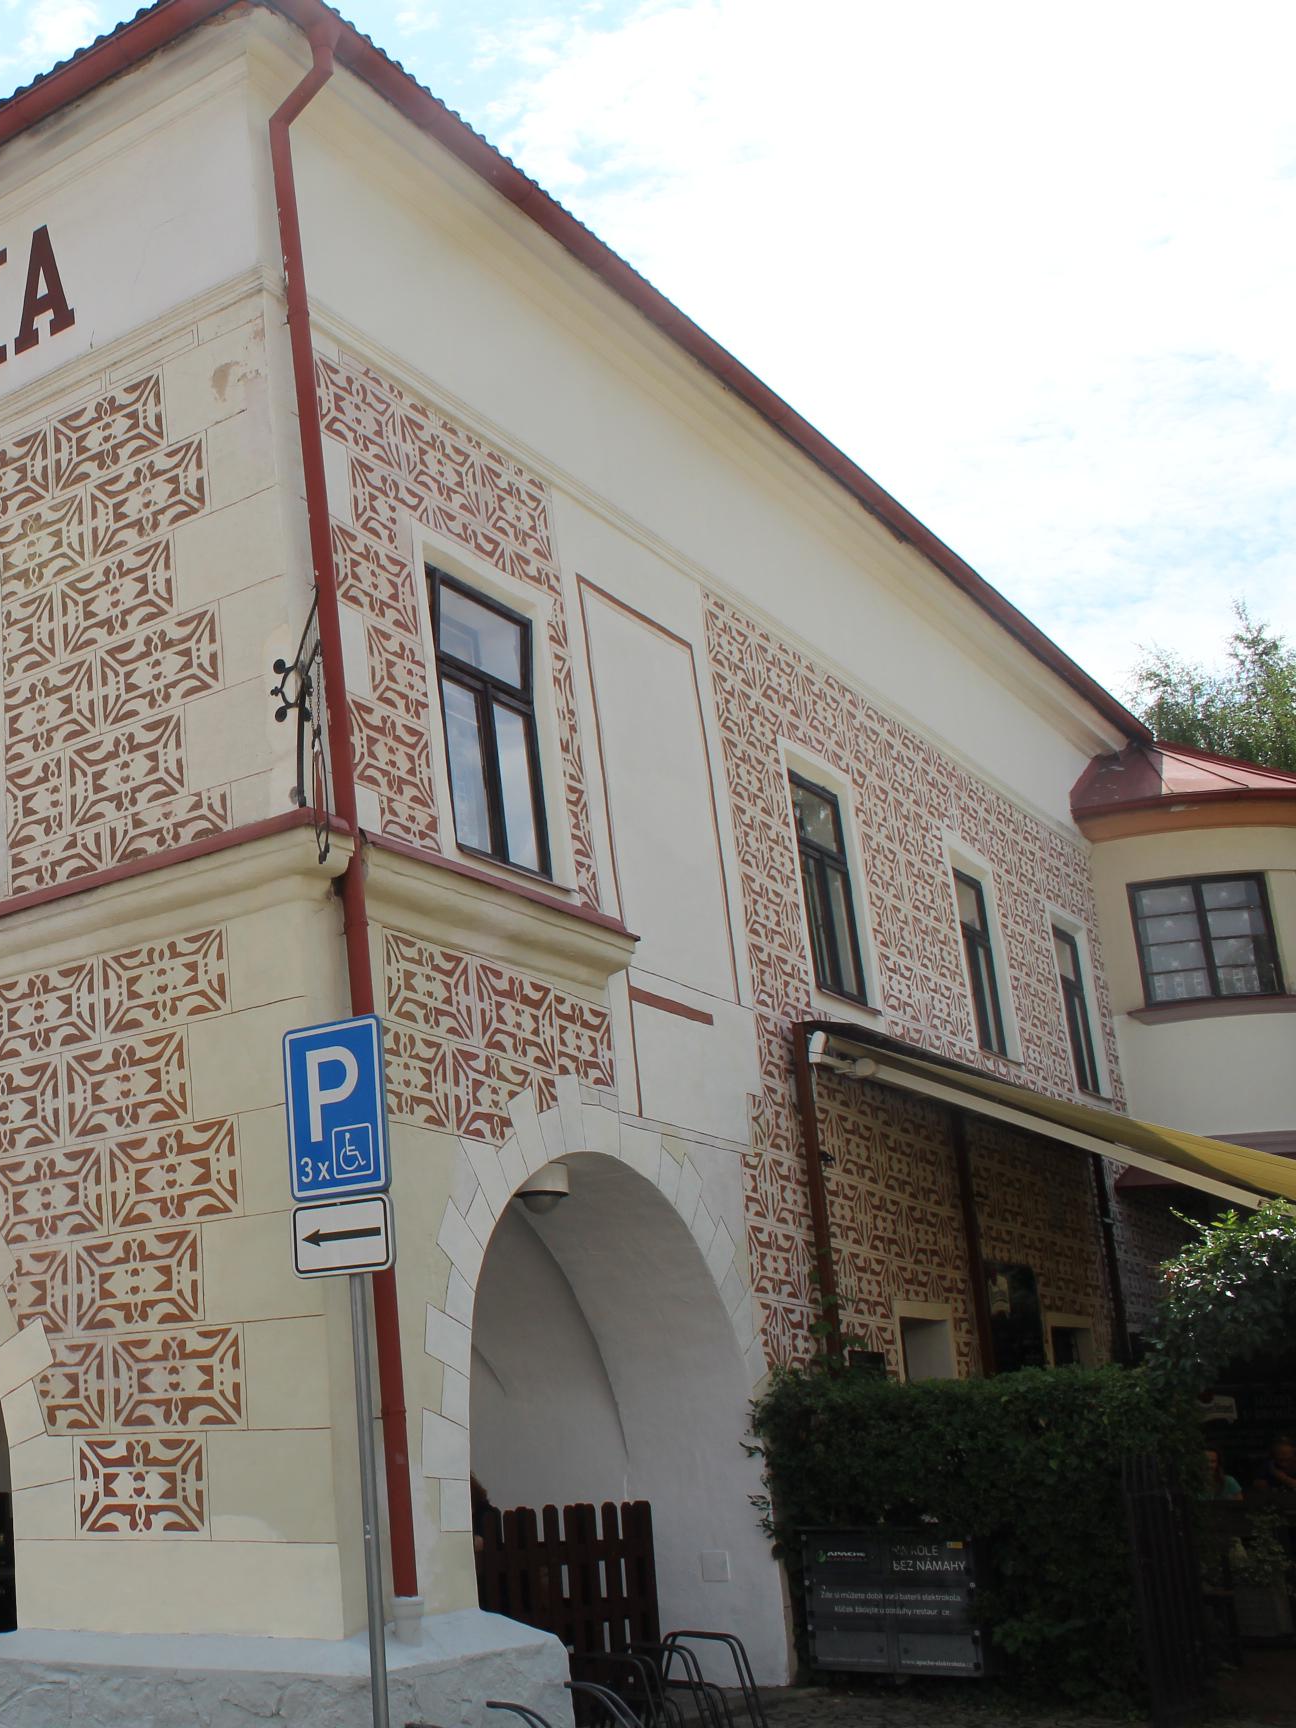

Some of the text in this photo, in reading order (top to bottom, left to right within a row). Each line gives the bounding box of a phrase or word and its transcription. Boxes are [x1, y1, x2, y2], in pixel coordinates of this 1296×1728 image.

[306, 1046, 359, 1143] P
[300, 1157, 330, 1183] 3 x
[916, 1557, 966, 1571] NÁMAHY
